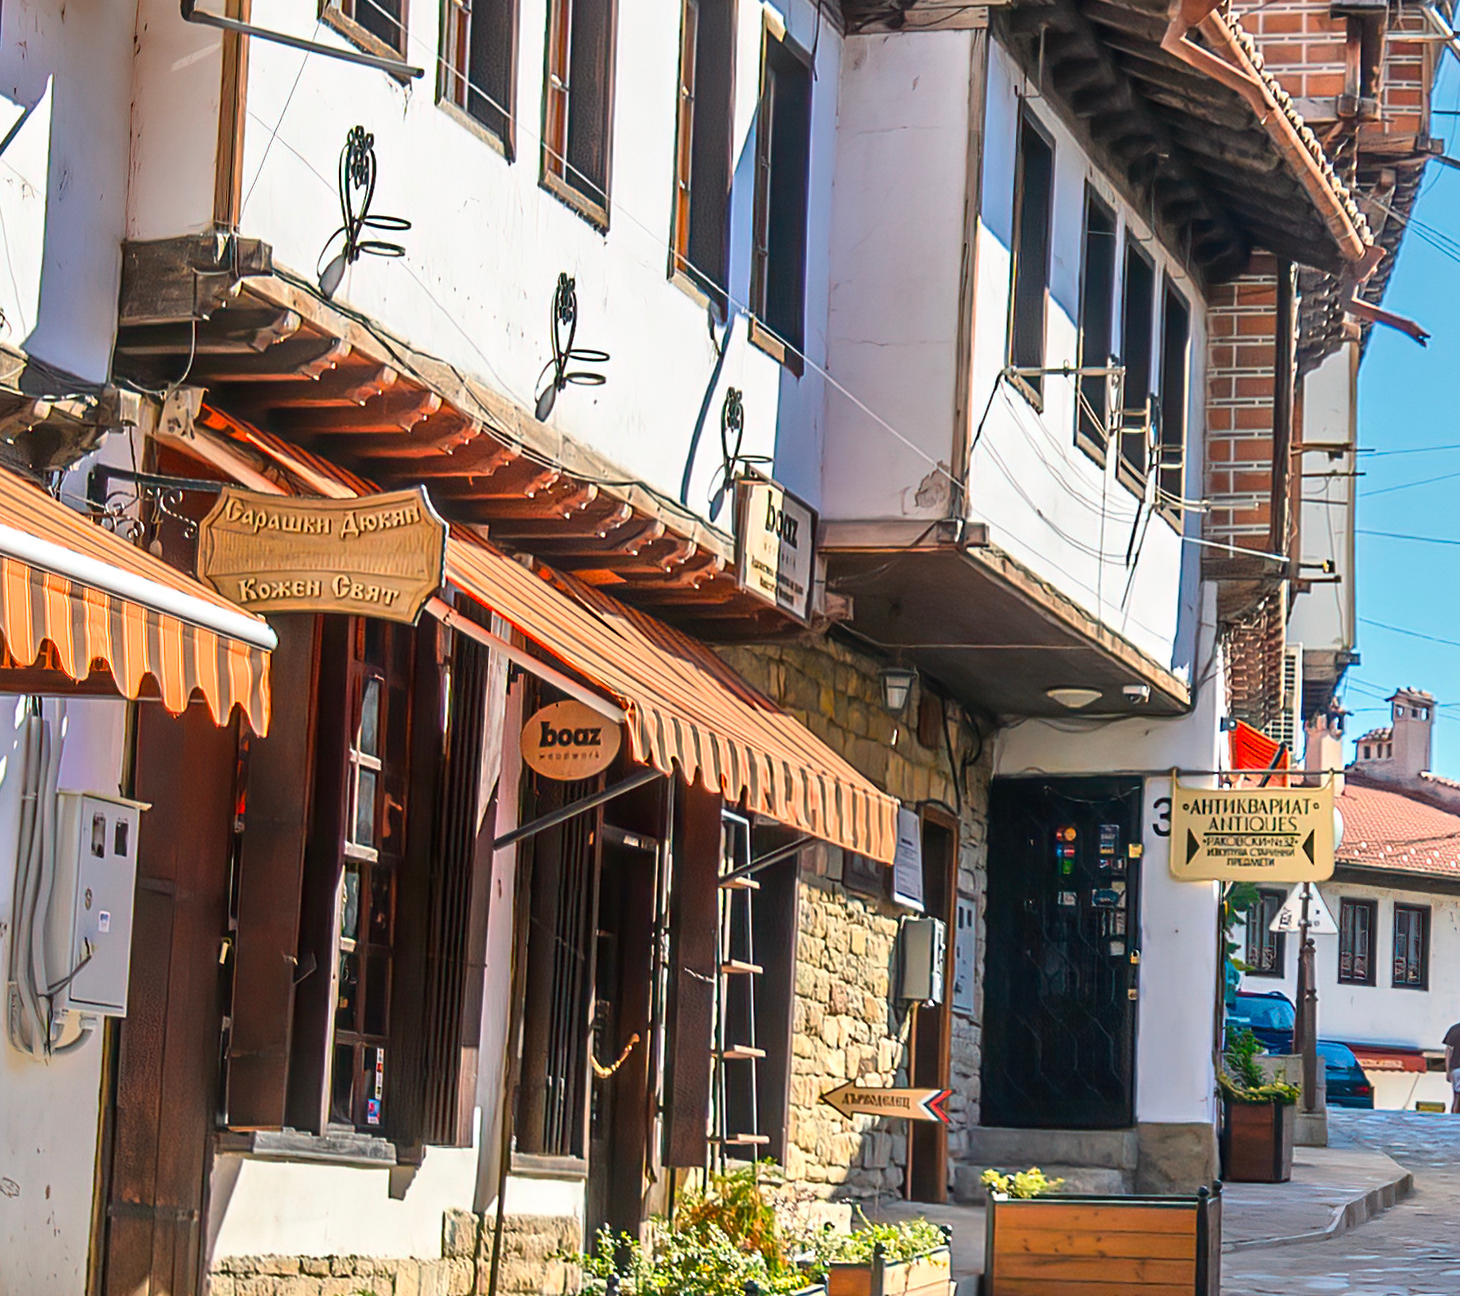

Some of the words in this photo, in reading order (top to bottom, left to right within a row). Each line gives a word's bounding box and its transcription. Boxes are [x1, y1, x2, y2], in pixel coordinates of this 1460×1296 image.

[239, 577, 323, 603] Кожен
[331, 574, 401, 605] Свят
[539, 720, 603, 747] boaz
[1190, 798, 1311, 815] АНТИКВАРИАТ
[1208, 816, 1298, 832] ANTIQUES
[1226, 858, 1276, 867] ПРЕДМЕТИ
